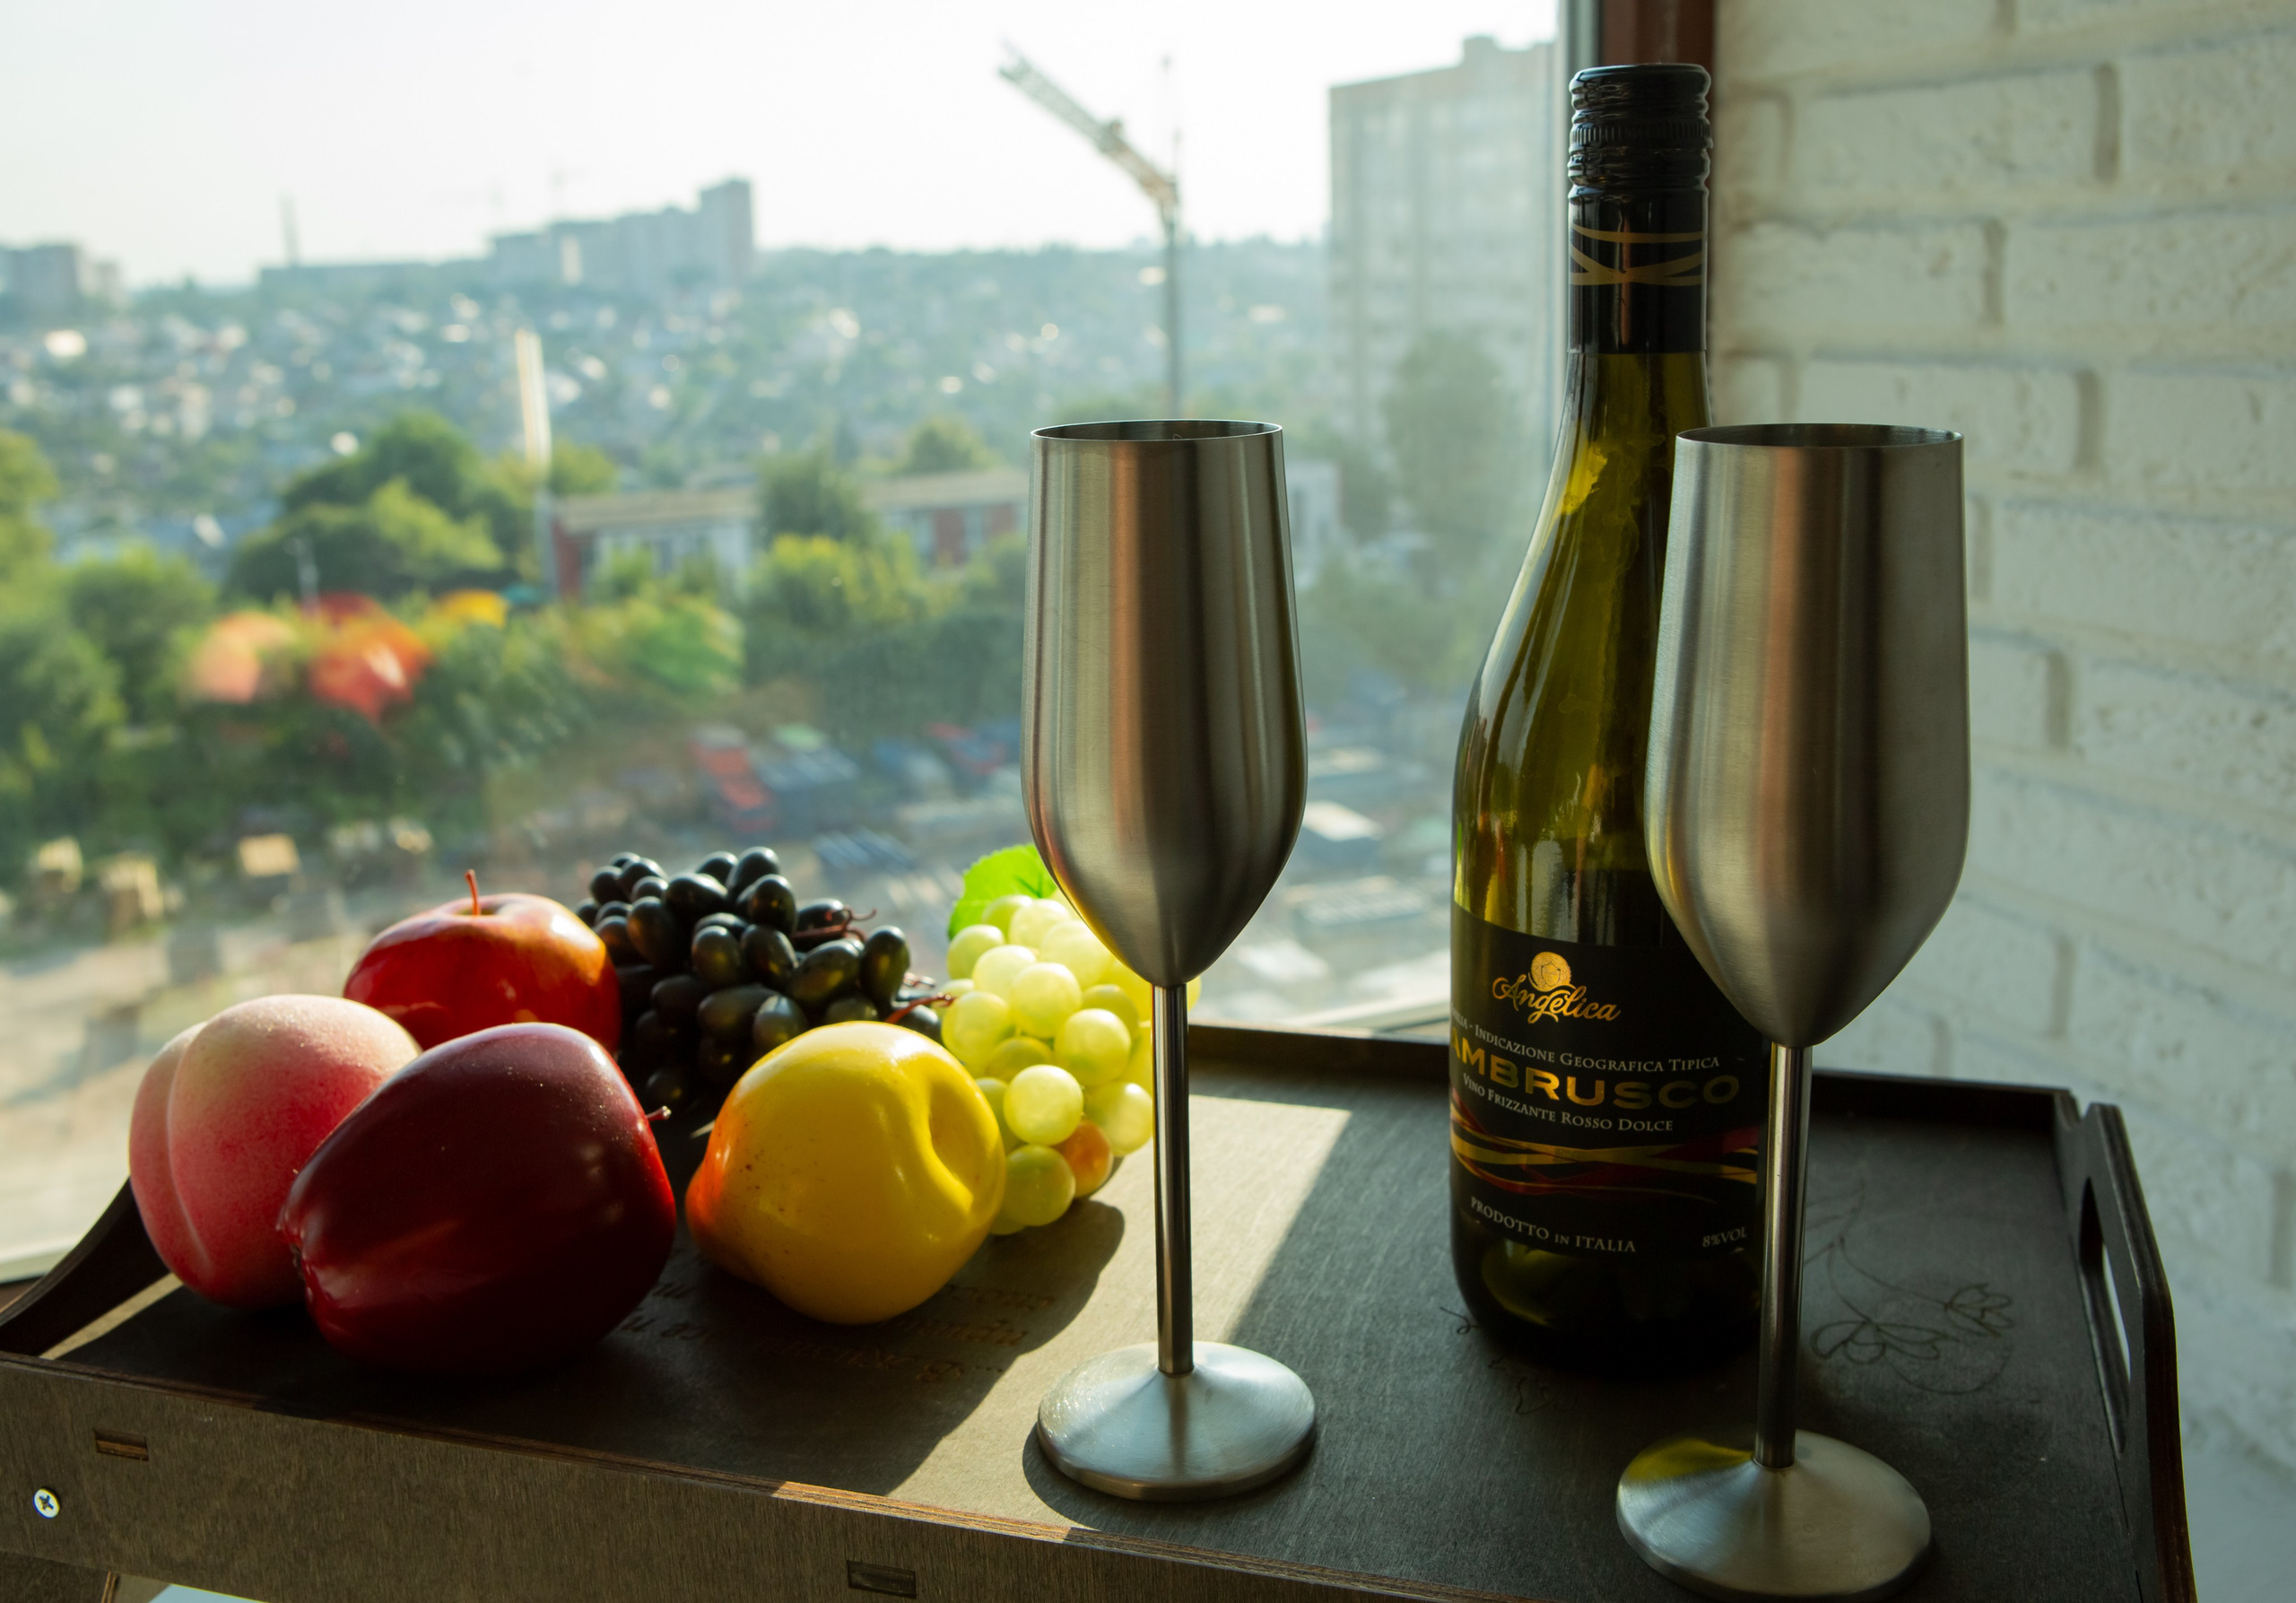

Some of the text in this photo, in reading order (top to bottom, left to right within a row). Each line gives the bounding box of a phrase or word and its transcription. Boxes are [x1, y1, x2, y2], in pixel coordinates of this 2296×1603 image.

[1492, 973, 1622, 1024] Angelica
[1450, 1025, 1740, 1111] AMBRUSCO
[1474, 1024, 1556, 1064] INDICAZIONE
[1560, 1051, 1665, 1073] GEOGRAFICA
[1668, 1056, 1720, 1072] TIPICA
[1463, 1072, 1674, 1132] VINO FRIZZANTE ROSSO DOLCE
[1470, 1195, 1637, 1253] PRODOTTO IN ITALIA
